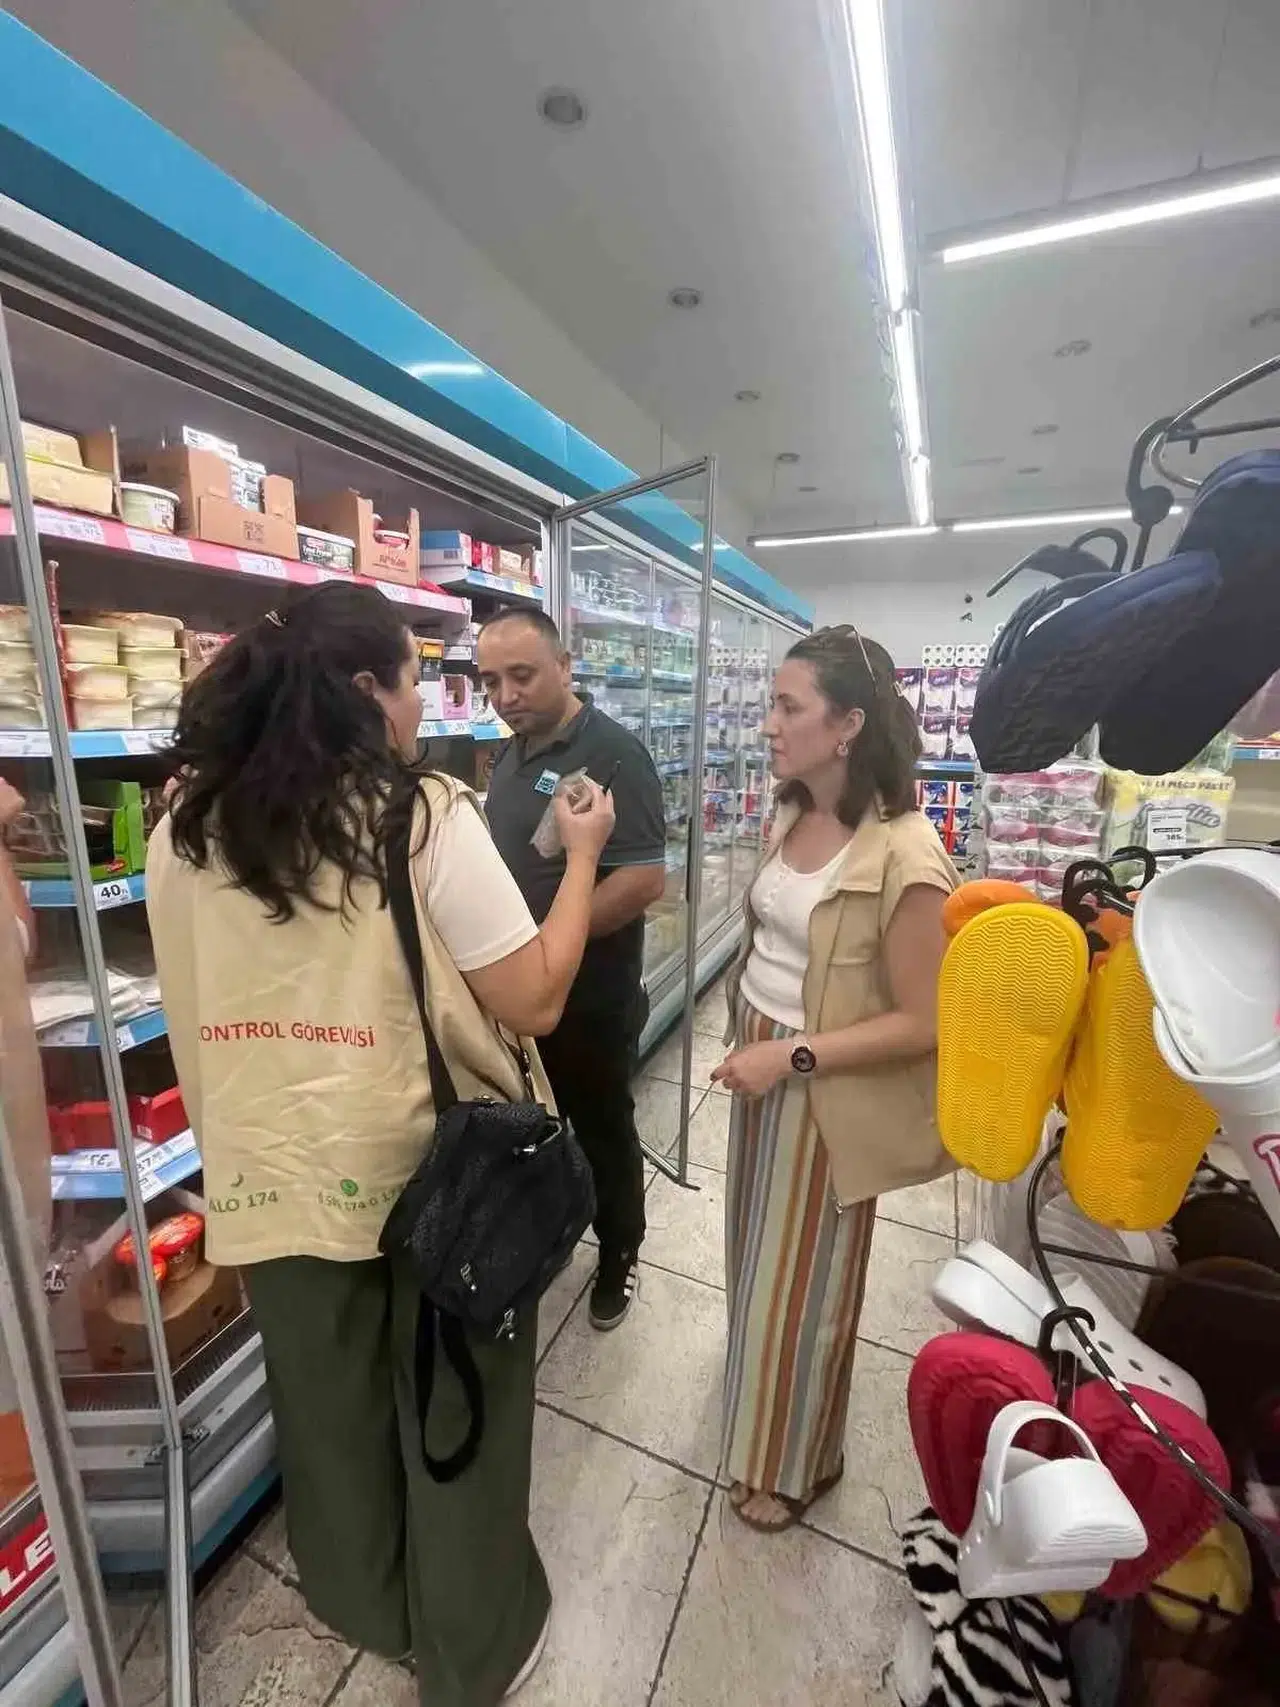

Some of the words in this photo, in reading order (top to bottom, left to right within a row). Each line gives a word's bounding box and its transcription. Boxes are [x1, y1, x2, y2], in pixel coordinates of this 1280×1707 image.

[101, 884, 122, 898] 40
[198, 1022, 287, 1042] ONTROL
[246, 1189, 279, 1209] 174
